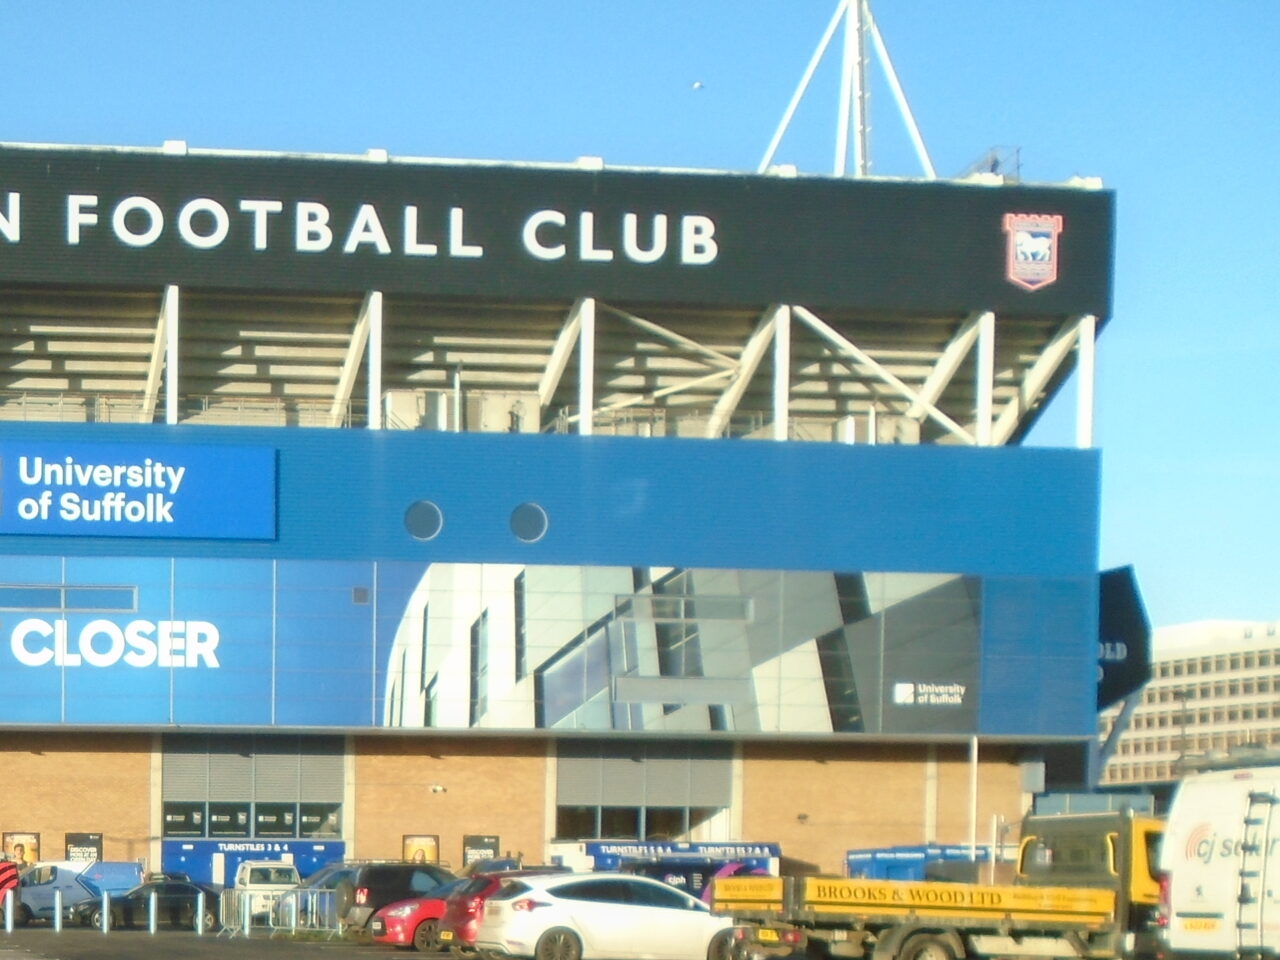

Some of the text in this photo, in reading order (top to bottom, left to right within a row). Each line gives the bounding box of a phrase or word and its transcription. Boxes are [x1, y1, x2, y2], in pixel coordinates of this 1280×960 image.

[66, 194, 483, 257] FOOTBALL
[522, 210, 719, 265] CLUB
[19, 456, 186, 494] University
[19, 490, 174, 523] of Suffolk
[10, 618, 221, 669] CLOSER
[918, 683, 966, 695] University
[918, 694, 962, 704] of Suffolk
[218, 843, 264, 851] TURNSTILES
[1197, 831, 1217, 864] cj
[817, 885, 887, 900] BROOKS
[891, 888, 903, 901] &
[908, 889, 965, 904] WOOD
[969, 892, 1003, 905] LTD
